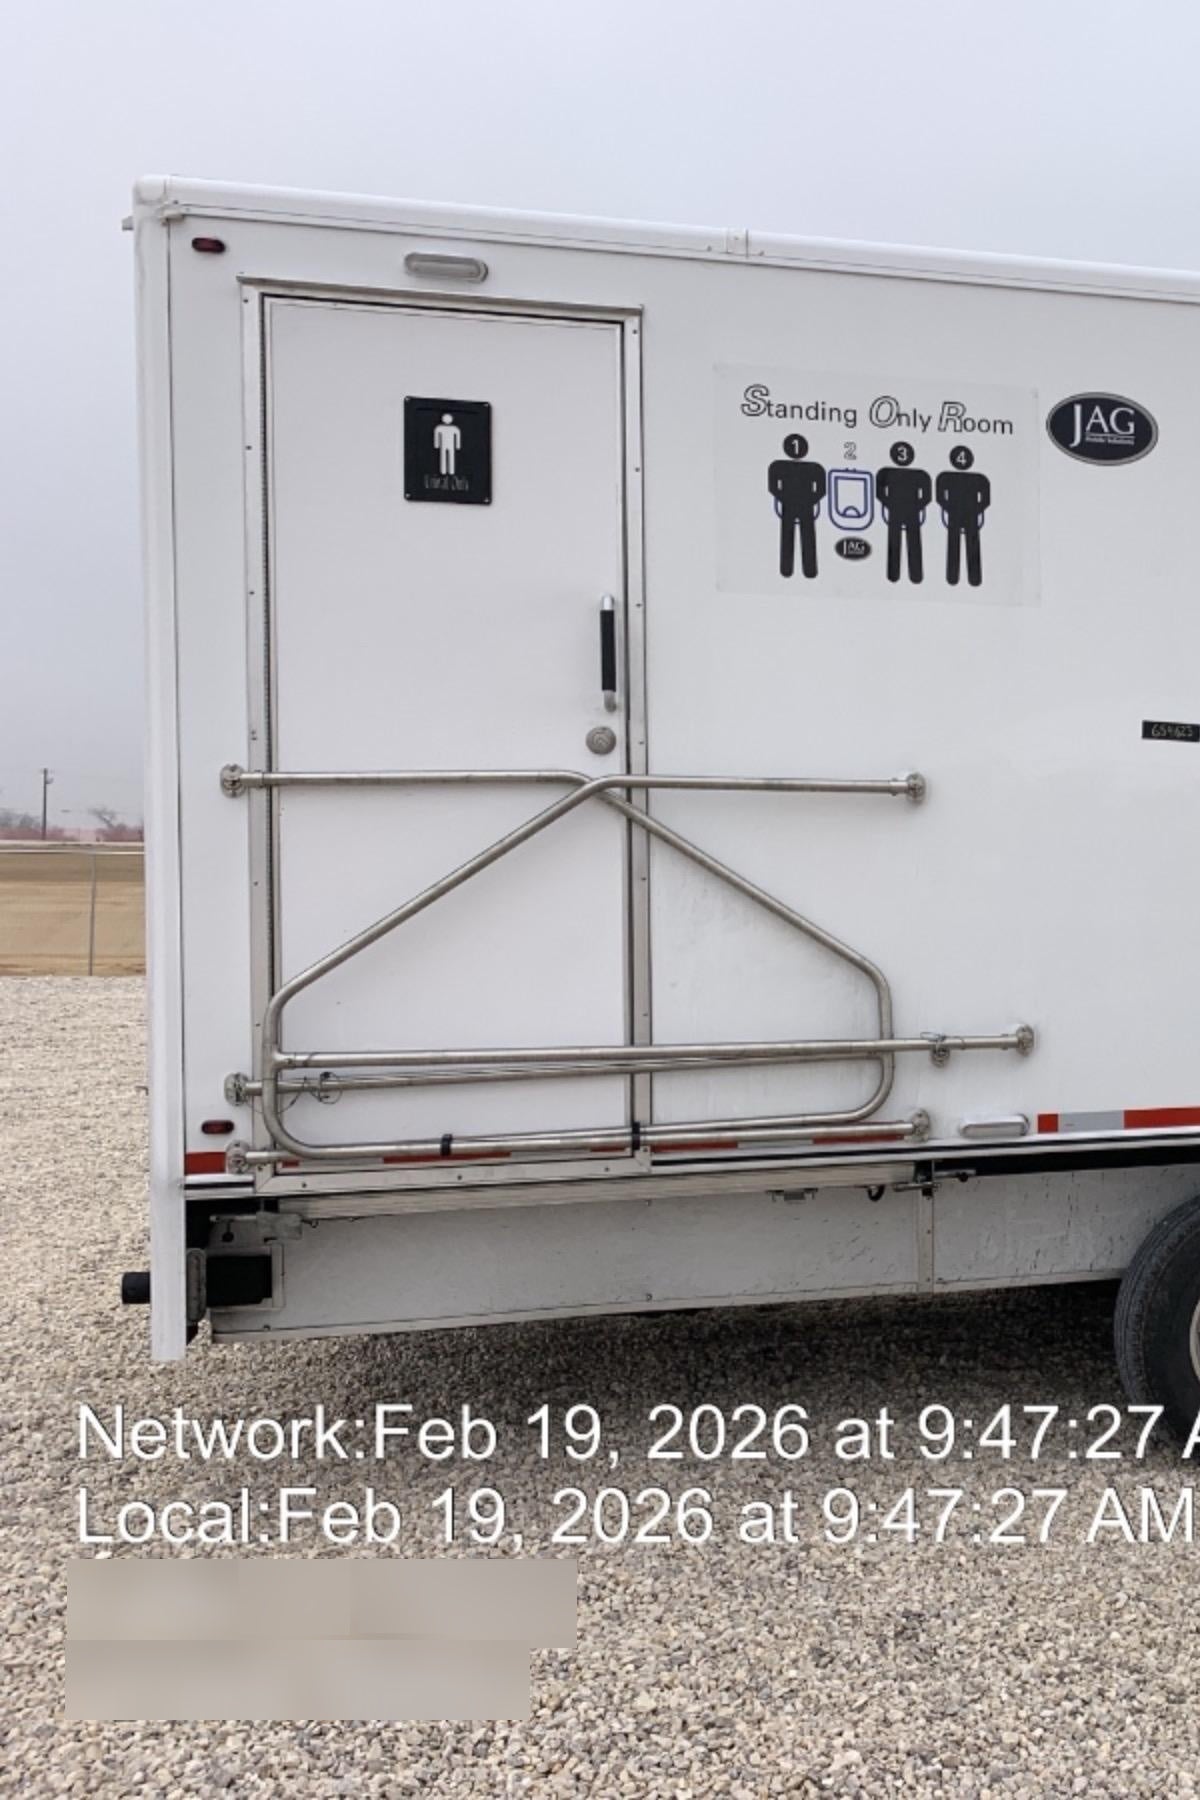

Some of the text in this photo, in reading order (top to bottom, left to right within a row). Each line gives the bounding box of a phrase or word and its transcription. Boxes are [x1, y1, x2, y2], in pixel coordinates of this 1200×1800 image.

[741, 384, 1014, 435] Standing Only Room
[1069, 403, 1136, 448] JAG
[791, 439, 967, 466] 1 2 3 4
